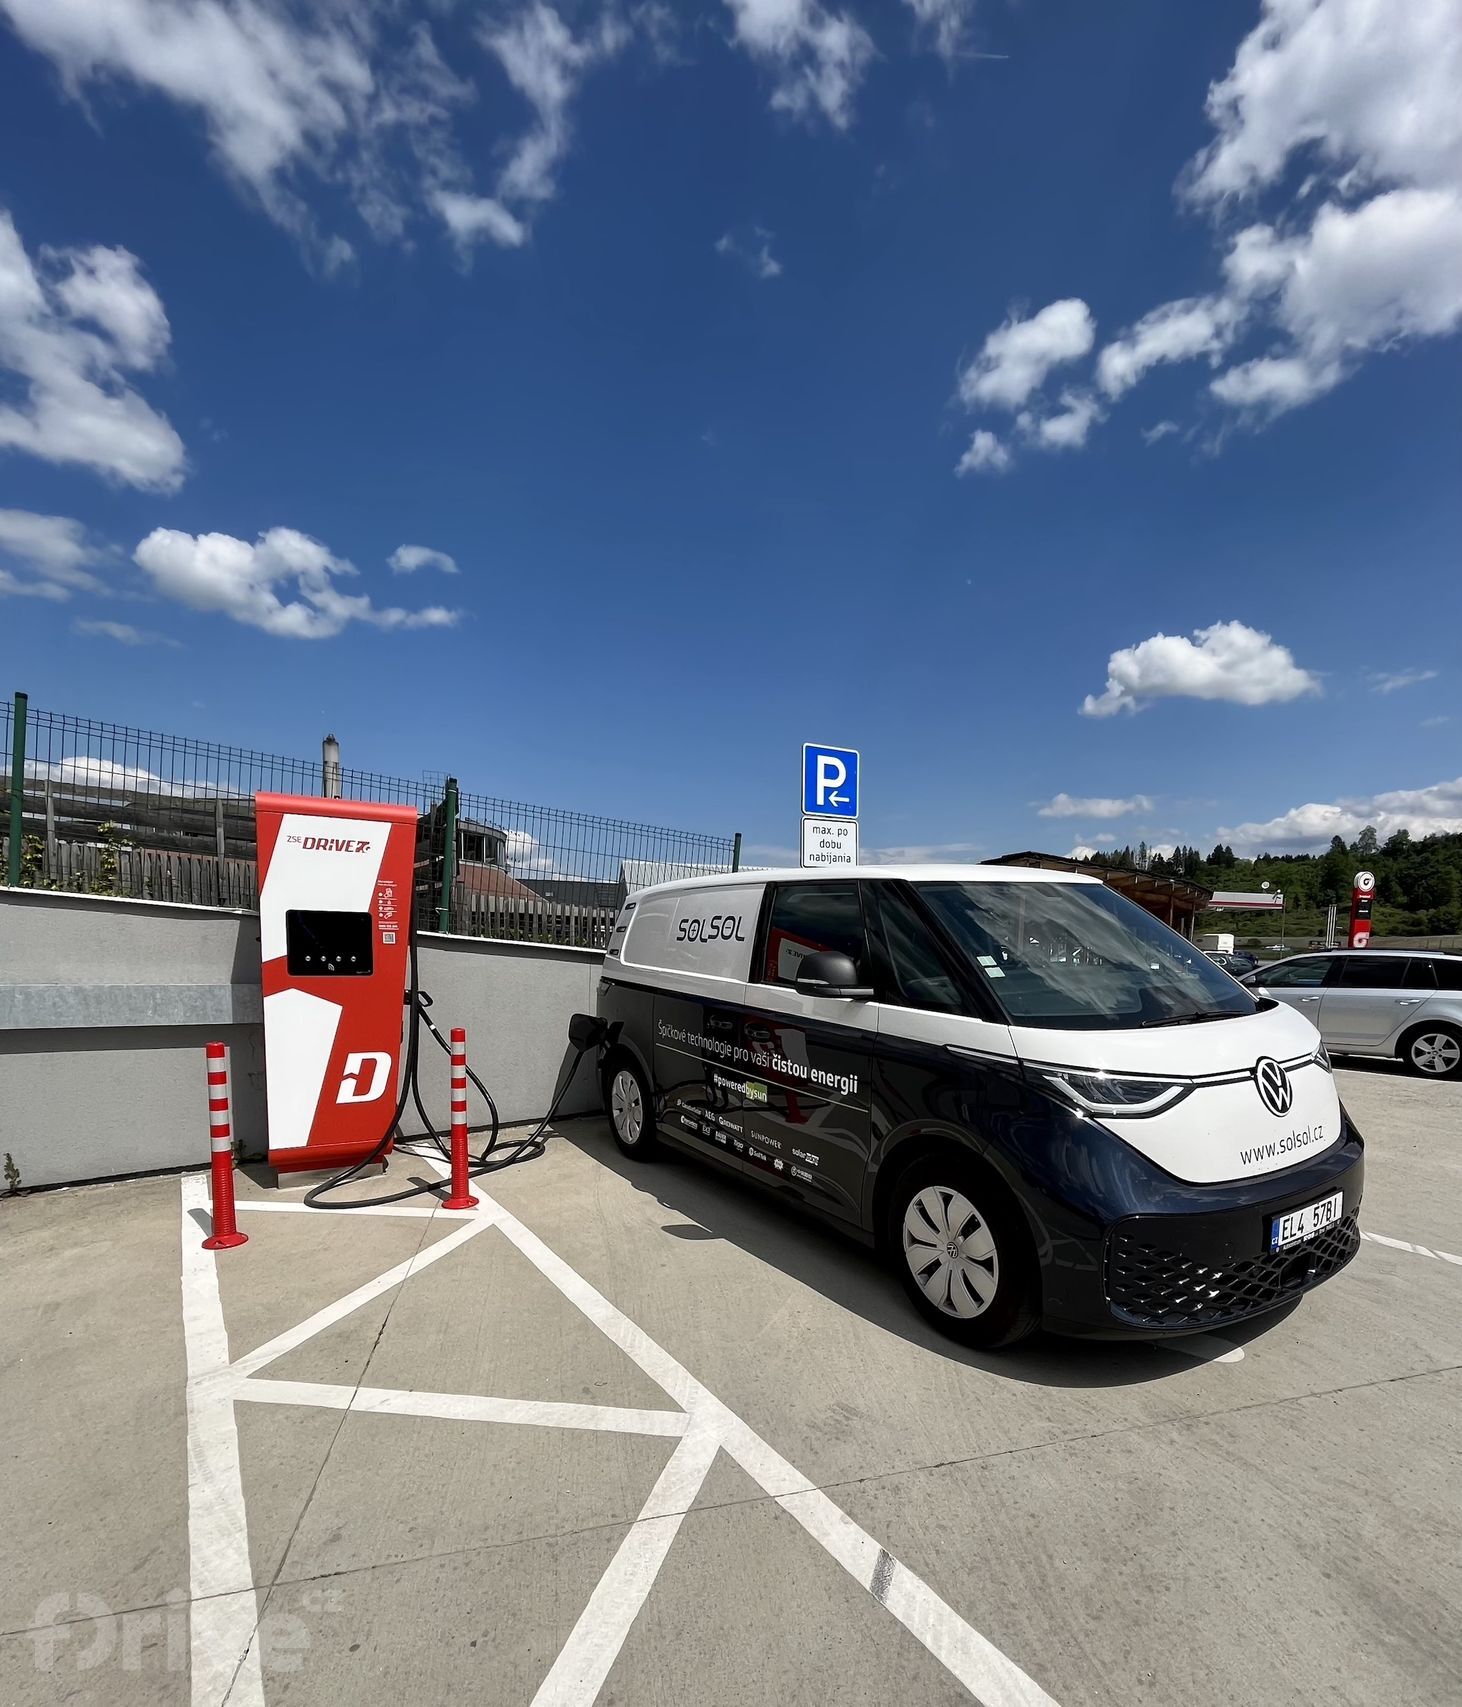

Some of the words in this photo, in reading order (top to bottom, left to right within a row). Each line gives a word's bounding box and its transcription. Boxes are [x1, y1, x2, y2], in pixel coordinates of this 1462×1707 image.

[816, 754, 847, 806] P
[286, 835, 302, 844] ZSE
[812, 825, 835, 836] max.
[837, 828, 849, 838] po
[819, 838, 842, 850] dobu
[809, 852, 852, 864] nabijania
[657, 1017, 687, 1043] Špičkové
[687, 1032, 732, 1059] technologie
[732, 1046, 749, 1062] pro
[750, 1050, 770, 1068] vaši
[772, 1053, 808, 1079] čistou
[810, 1068, 858, 1096] energii
[1239, 1125, 1324, 1165] www.solsol.cz
[1282, 1212, 1305, 1242] EL4
